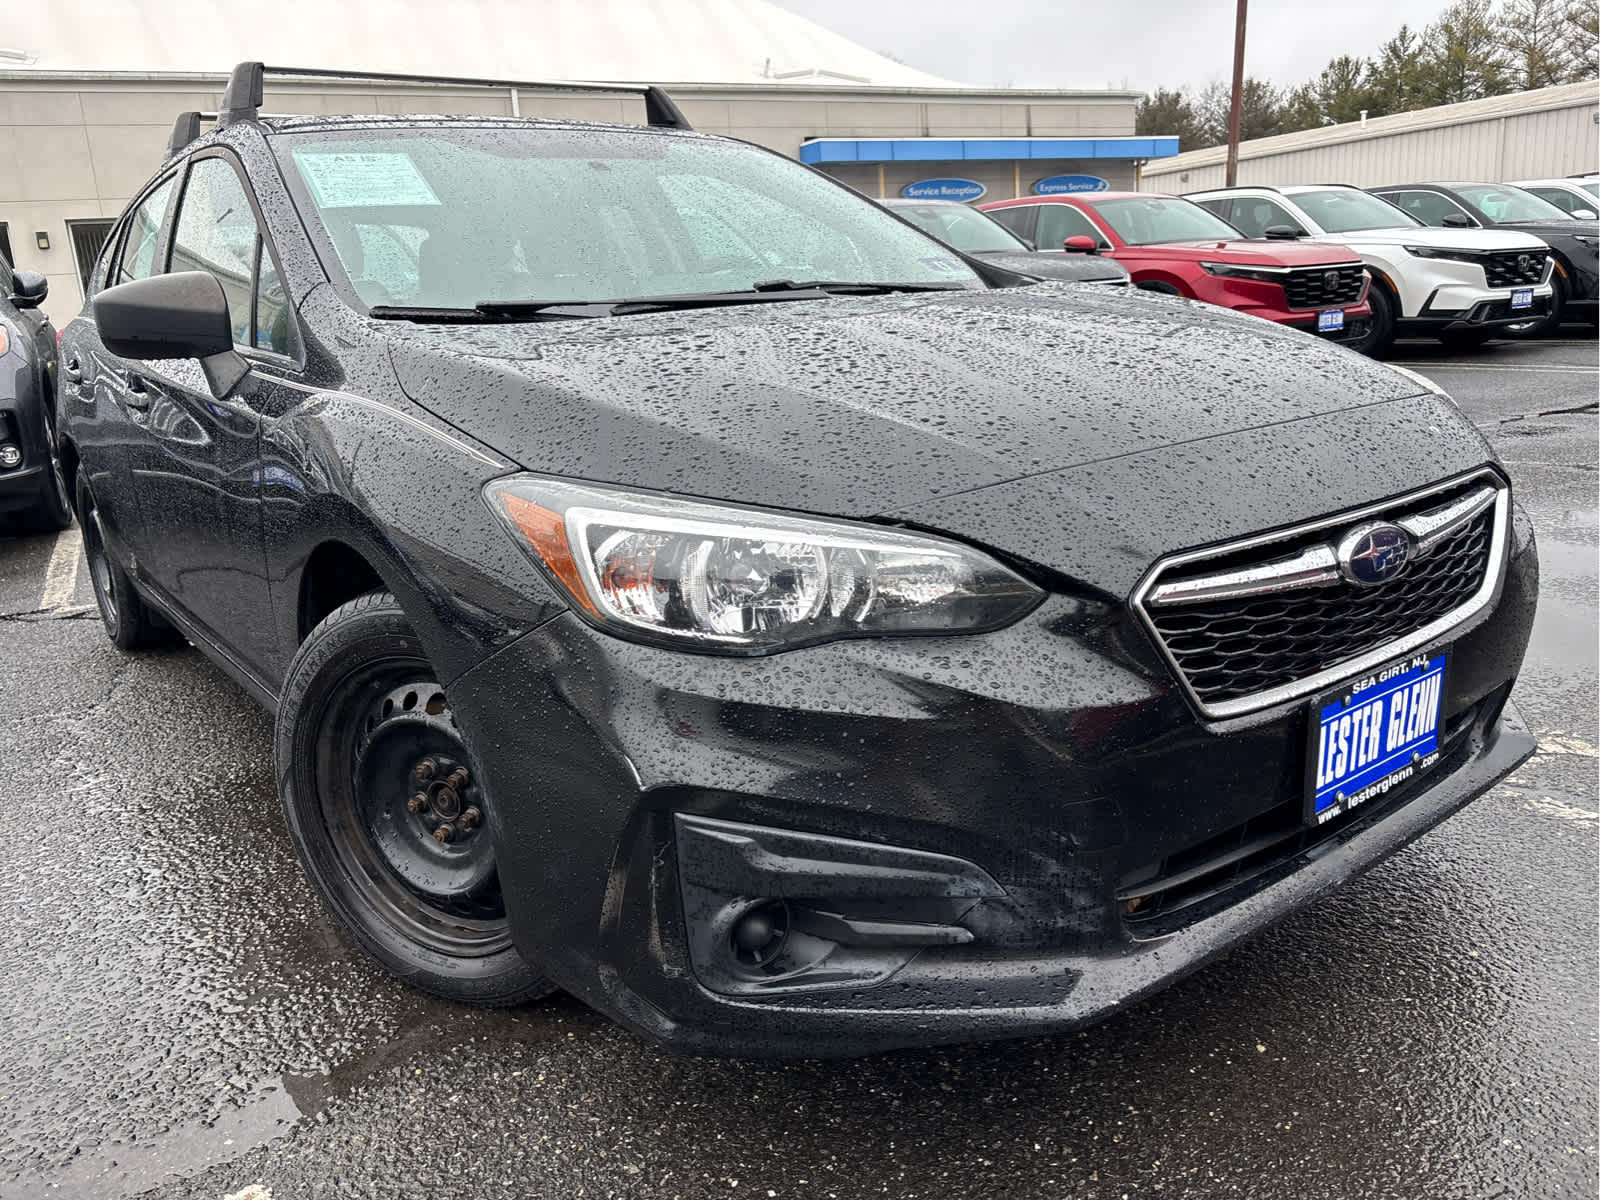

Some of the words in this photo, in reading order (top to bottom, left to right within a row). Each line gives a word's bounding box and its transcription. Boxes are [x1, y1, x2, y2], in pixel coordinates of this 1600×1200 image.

[908, 186, 939, 197] Service
[941, 185, 981, 197] Reception
[1040, 183, 1066, 193] Express
[1068, 182, 1094, 192] Service
[1352, 677, 1377, 695] SEA
[1316, 700, 1384, 790] LESTER
[1386, 673, 1442, 752] GLENN
